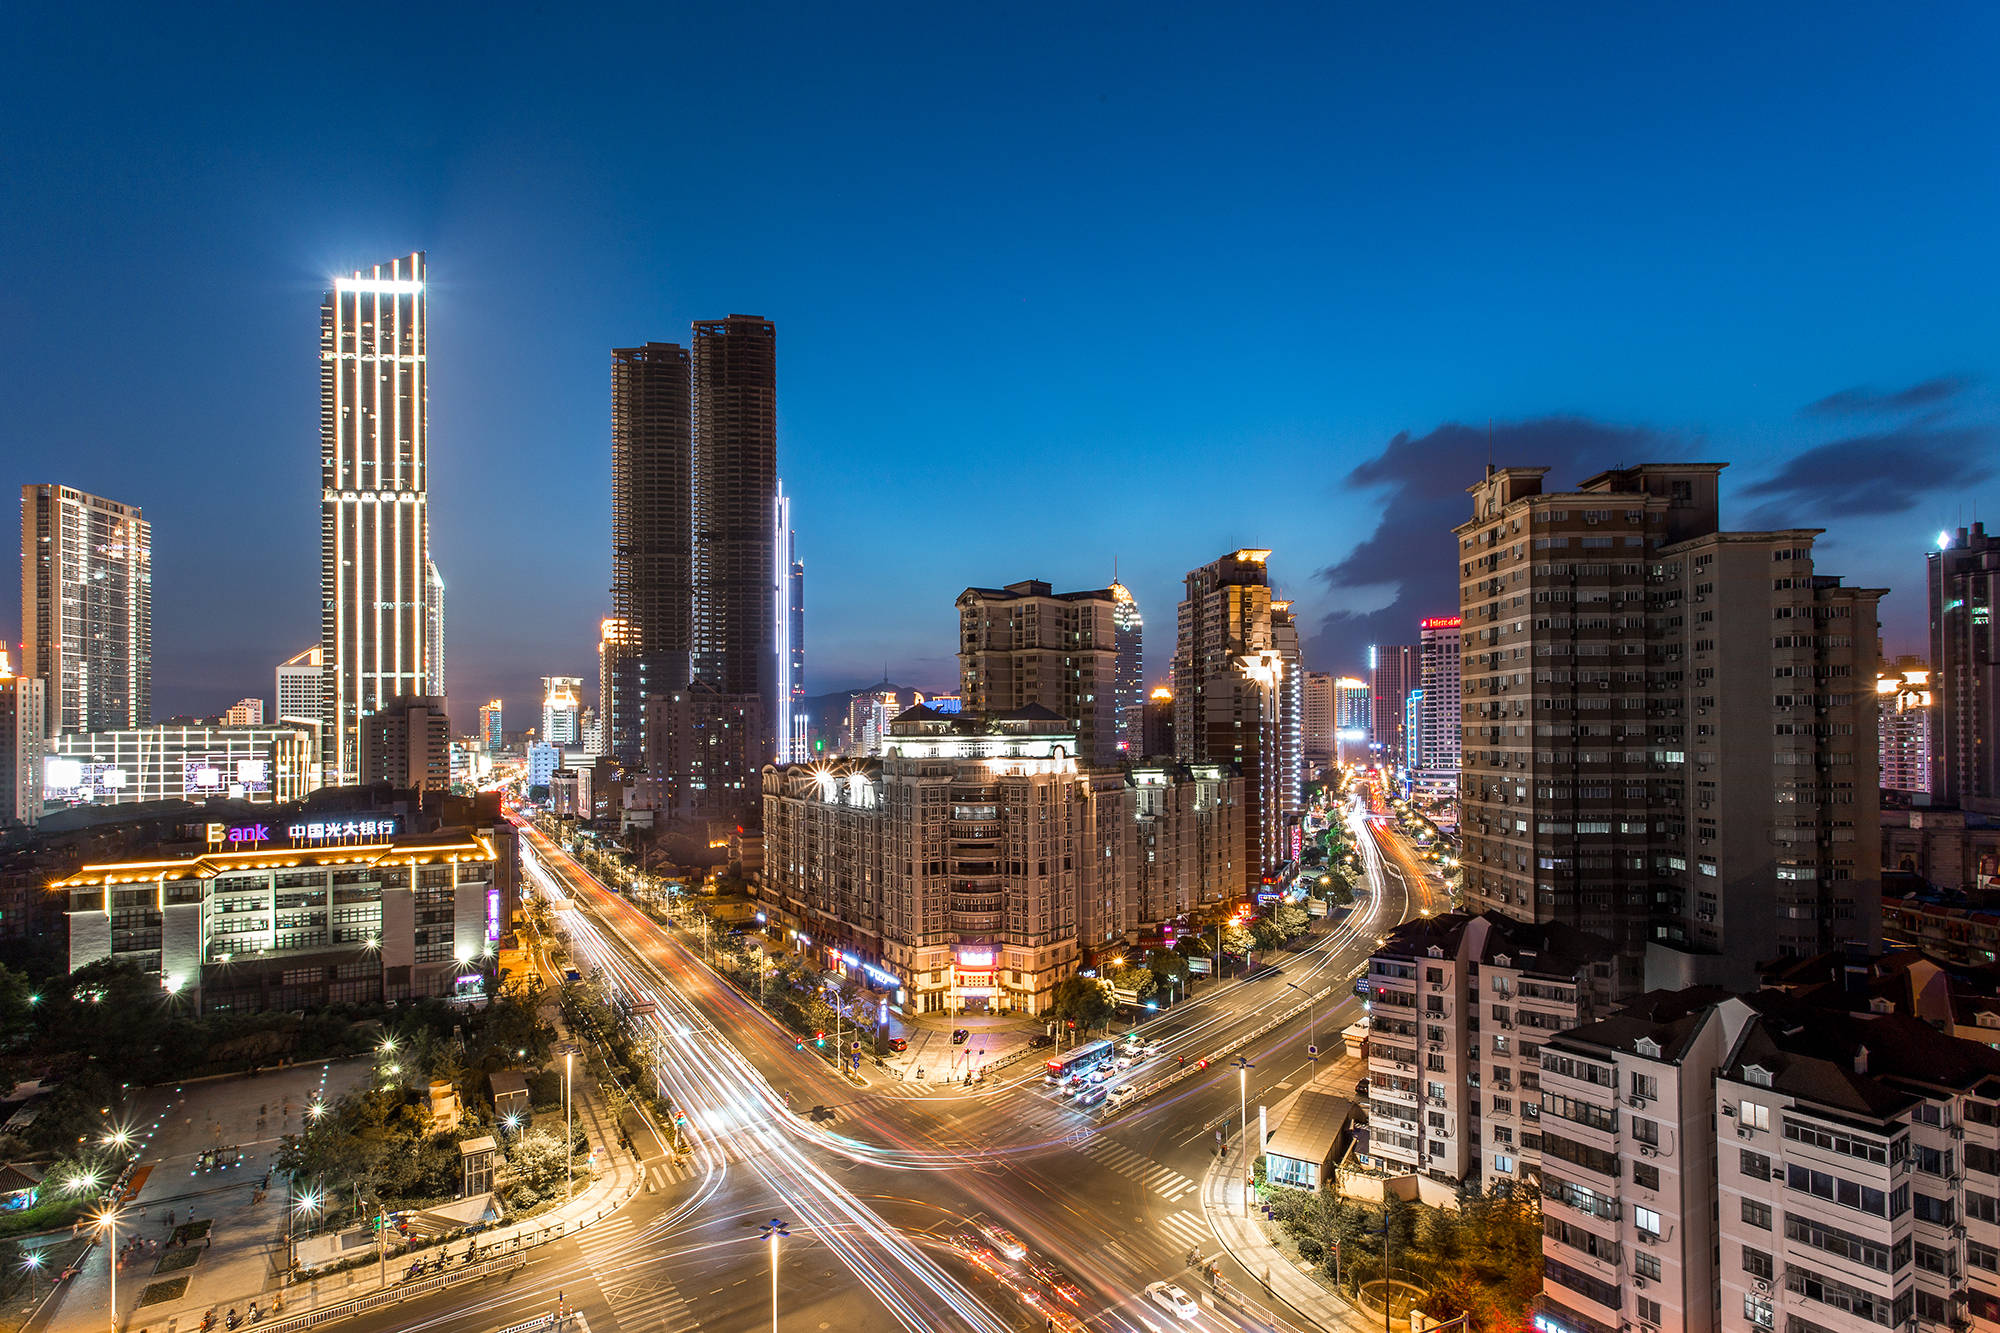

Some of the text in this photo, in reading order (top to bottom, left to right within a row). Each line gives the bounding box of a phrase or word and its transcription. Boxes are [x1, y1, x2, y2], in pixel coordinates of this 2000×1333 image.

[206, 822, 270, 843] Bank
[288, 821, 394, 839] 中国光大银行
